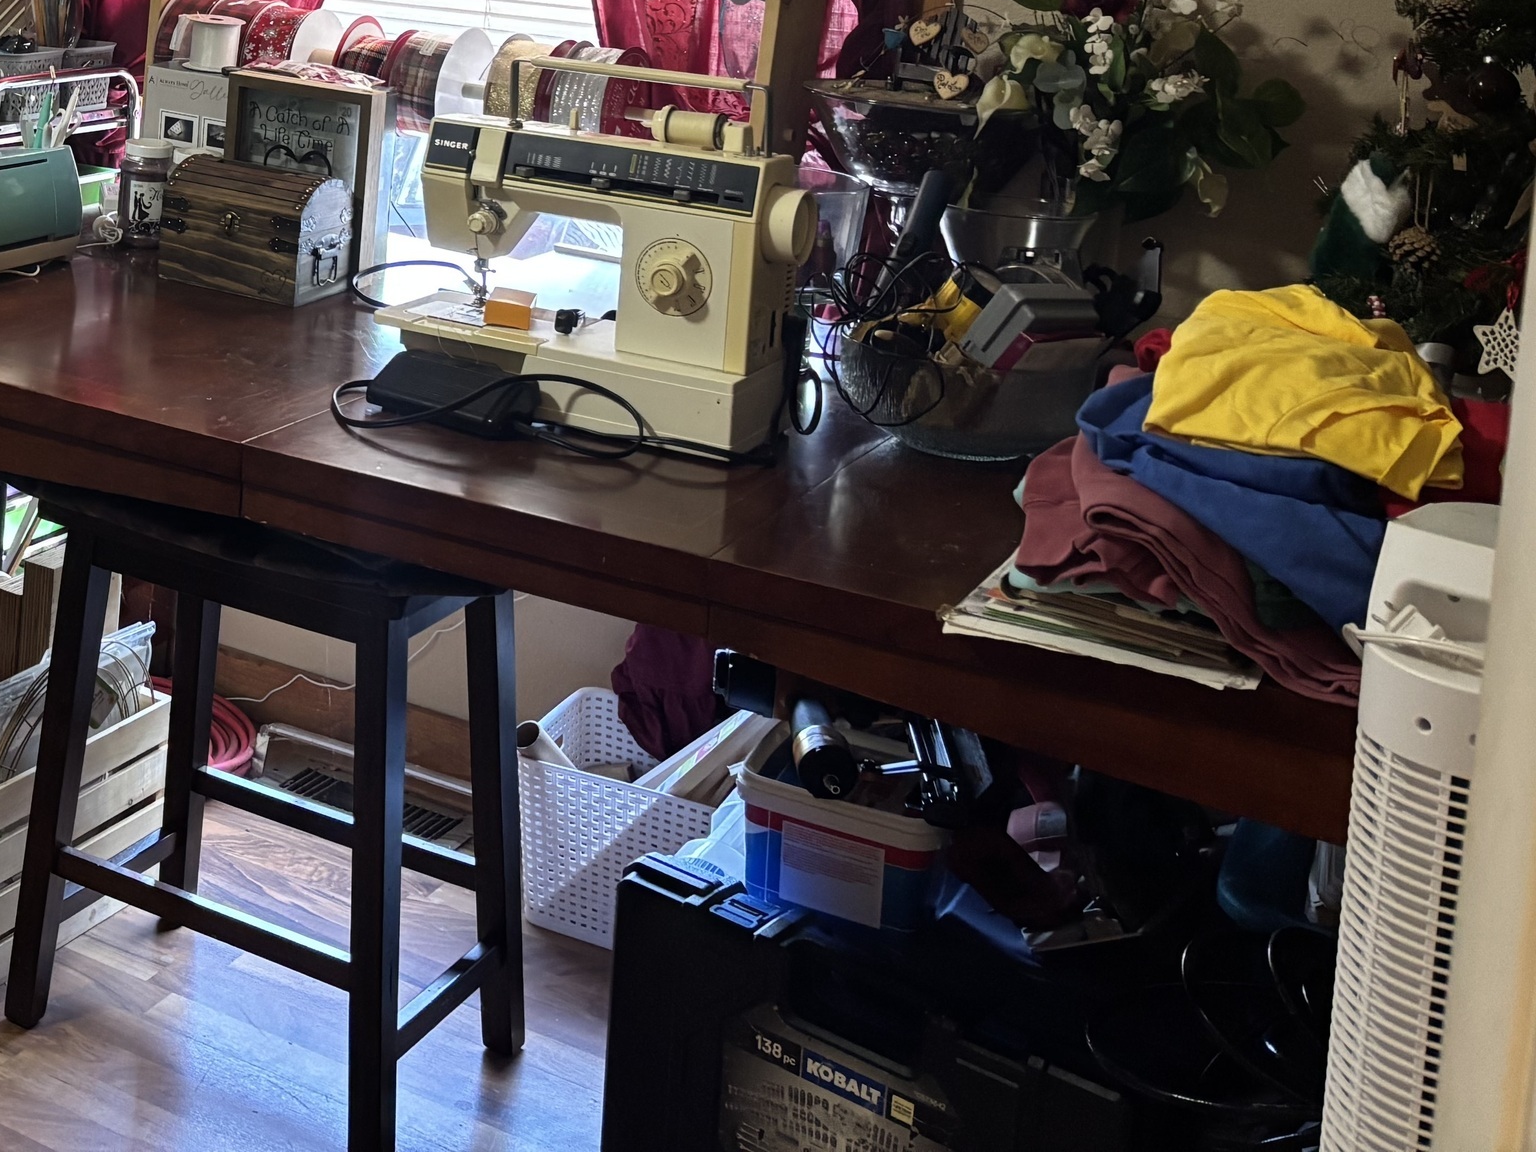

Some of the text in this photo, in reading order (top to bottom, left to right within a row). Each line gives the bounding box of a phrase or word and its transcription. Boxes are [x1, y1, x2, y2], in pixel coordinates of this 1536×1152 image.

[249, 100, 262, 119] A
[265, 105, 308, 127] Catch
[312, 115, 332, 132] of
[434, 139, 469, 150] SINGER
[755, 1034, 797, 1067] 138 pc
[805, 1056, 883, 1106] KOBALT
